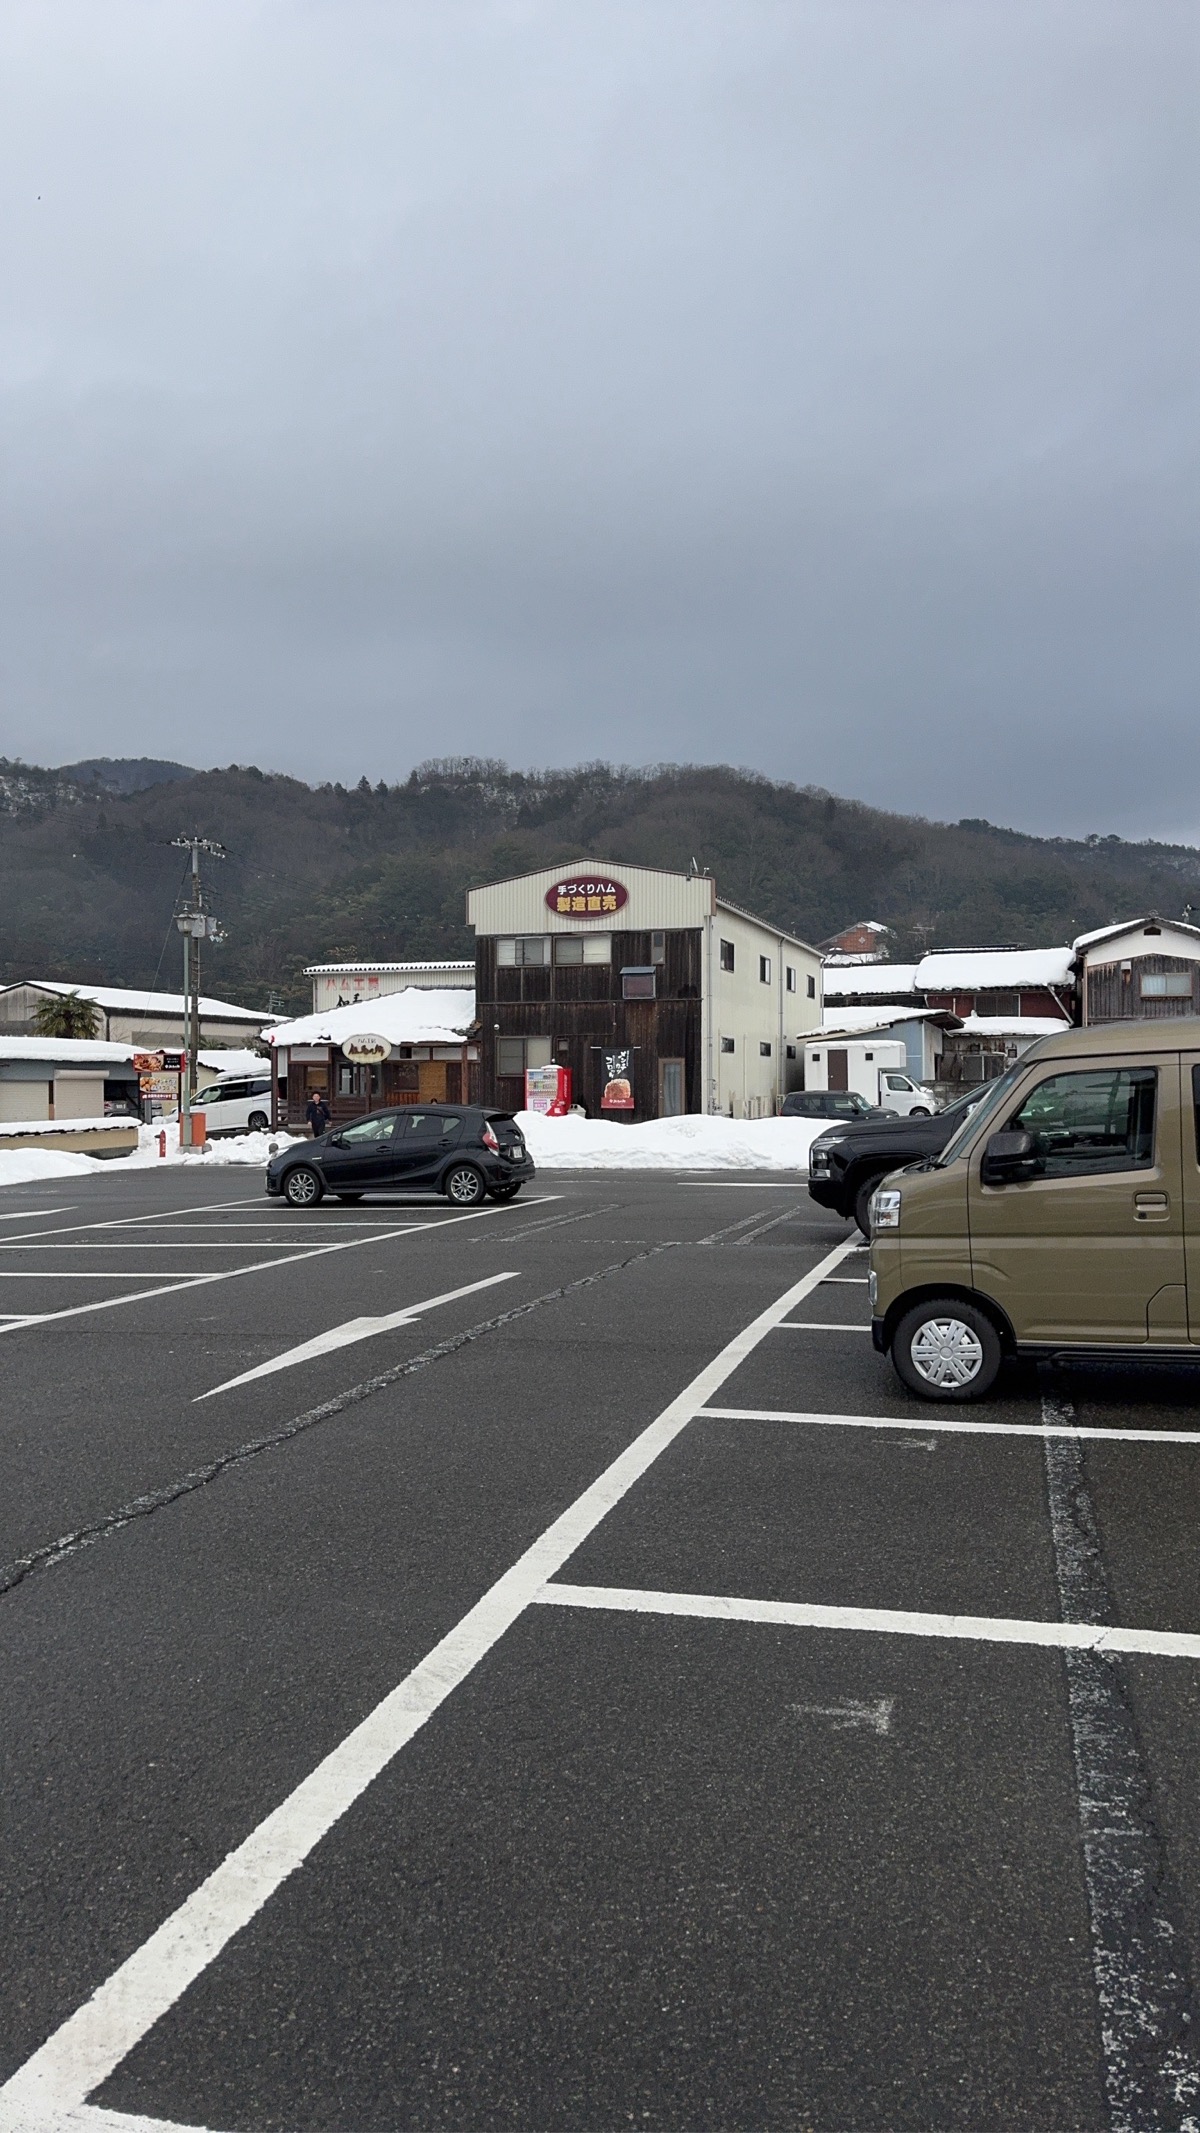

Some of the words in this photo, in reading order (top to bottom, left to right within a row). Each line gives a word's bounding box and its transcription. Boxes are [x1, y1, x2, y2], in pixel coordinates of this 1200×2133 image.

[557, 883, 616, 895] 手づくりハム
[556, 895, 617, 912] 製造直売
[326, 976, 379, 991] ハム工房
